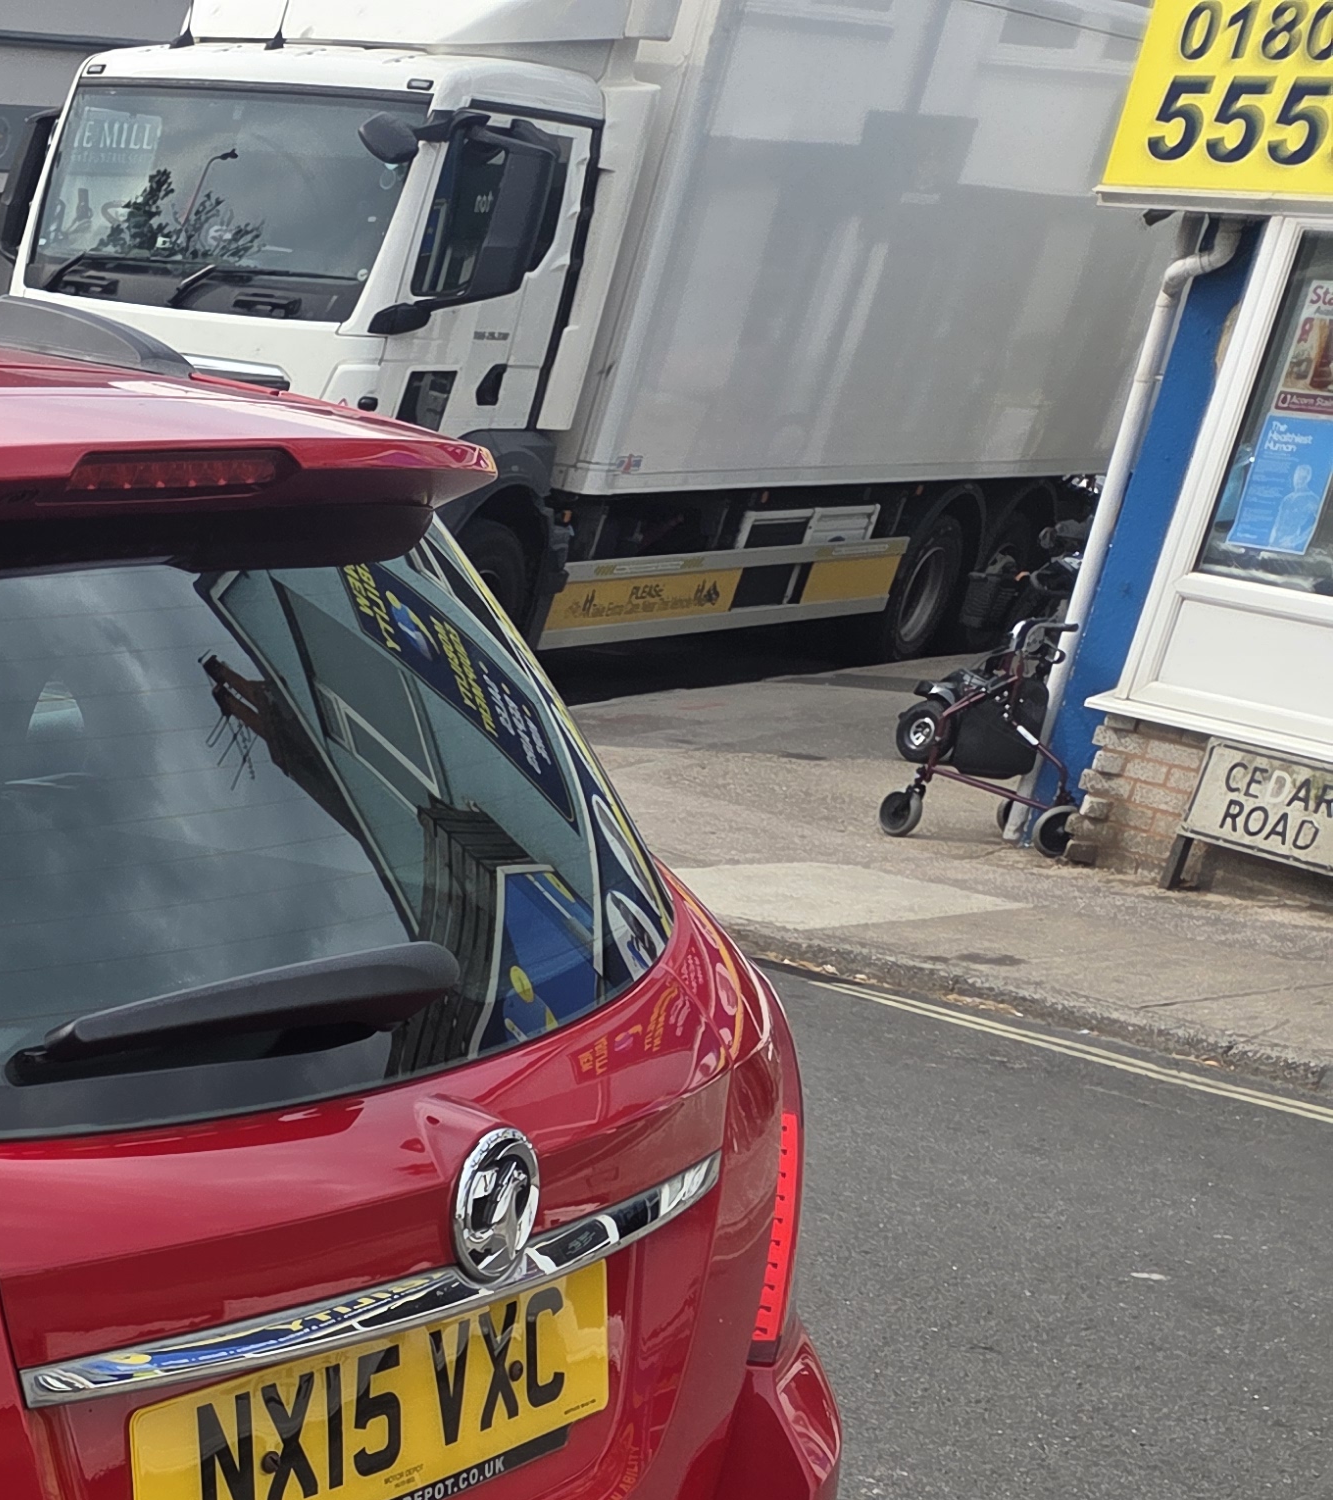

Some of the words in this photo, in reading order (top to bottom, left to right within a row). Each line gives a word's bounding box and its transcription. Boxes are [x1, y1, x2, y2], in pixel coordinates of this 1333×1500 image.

[1272, 420, 1288, 432] The
[1264, 440, 1297, 452] Human
[1267, 430, 1314, 445] Healthiest
[1225, 762, 1333, 819] CEDAR
[1219, 799, 1320, 851] ROAD
[429, 1286, 565, 1447] VXC
[384, 1471, 404, 1484] MOTOR
[405, 1464, 424, 1477] DEPOT
